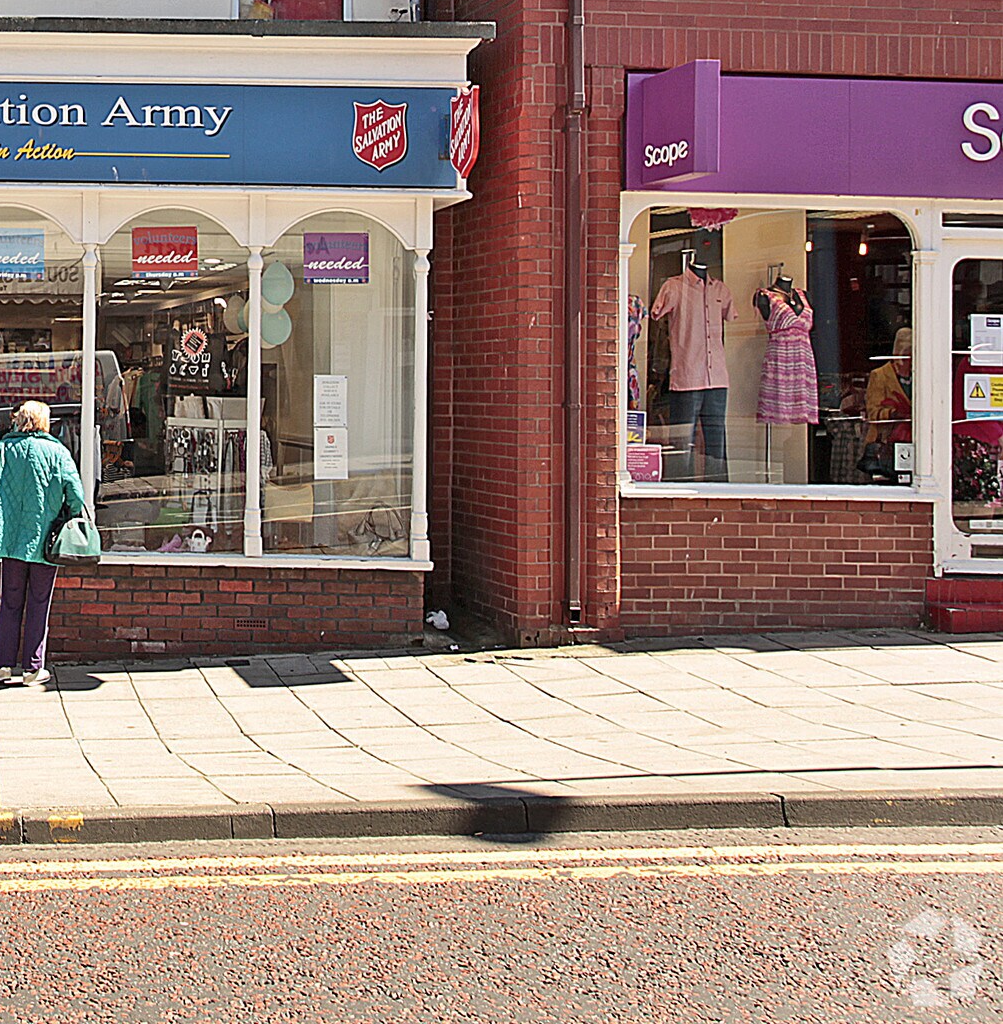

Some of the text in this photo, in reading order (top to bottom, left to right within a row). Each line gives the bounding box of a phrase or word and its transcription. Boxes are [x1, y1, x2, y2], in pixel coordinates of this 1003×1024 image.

[101, 96, 233, 136] Army
[362, 106, 384, 129] THE
[355, 110, 402, 153] SALVATION
[14, 138, 76, 161] Action
[371, 131, 401, 162] ARMY
[644, 140, 688, 167] Scope
[134, 231, 197, 246] volunteers
[137, 249, 194, 264] needed
[308, 256, 365, 270] needed
